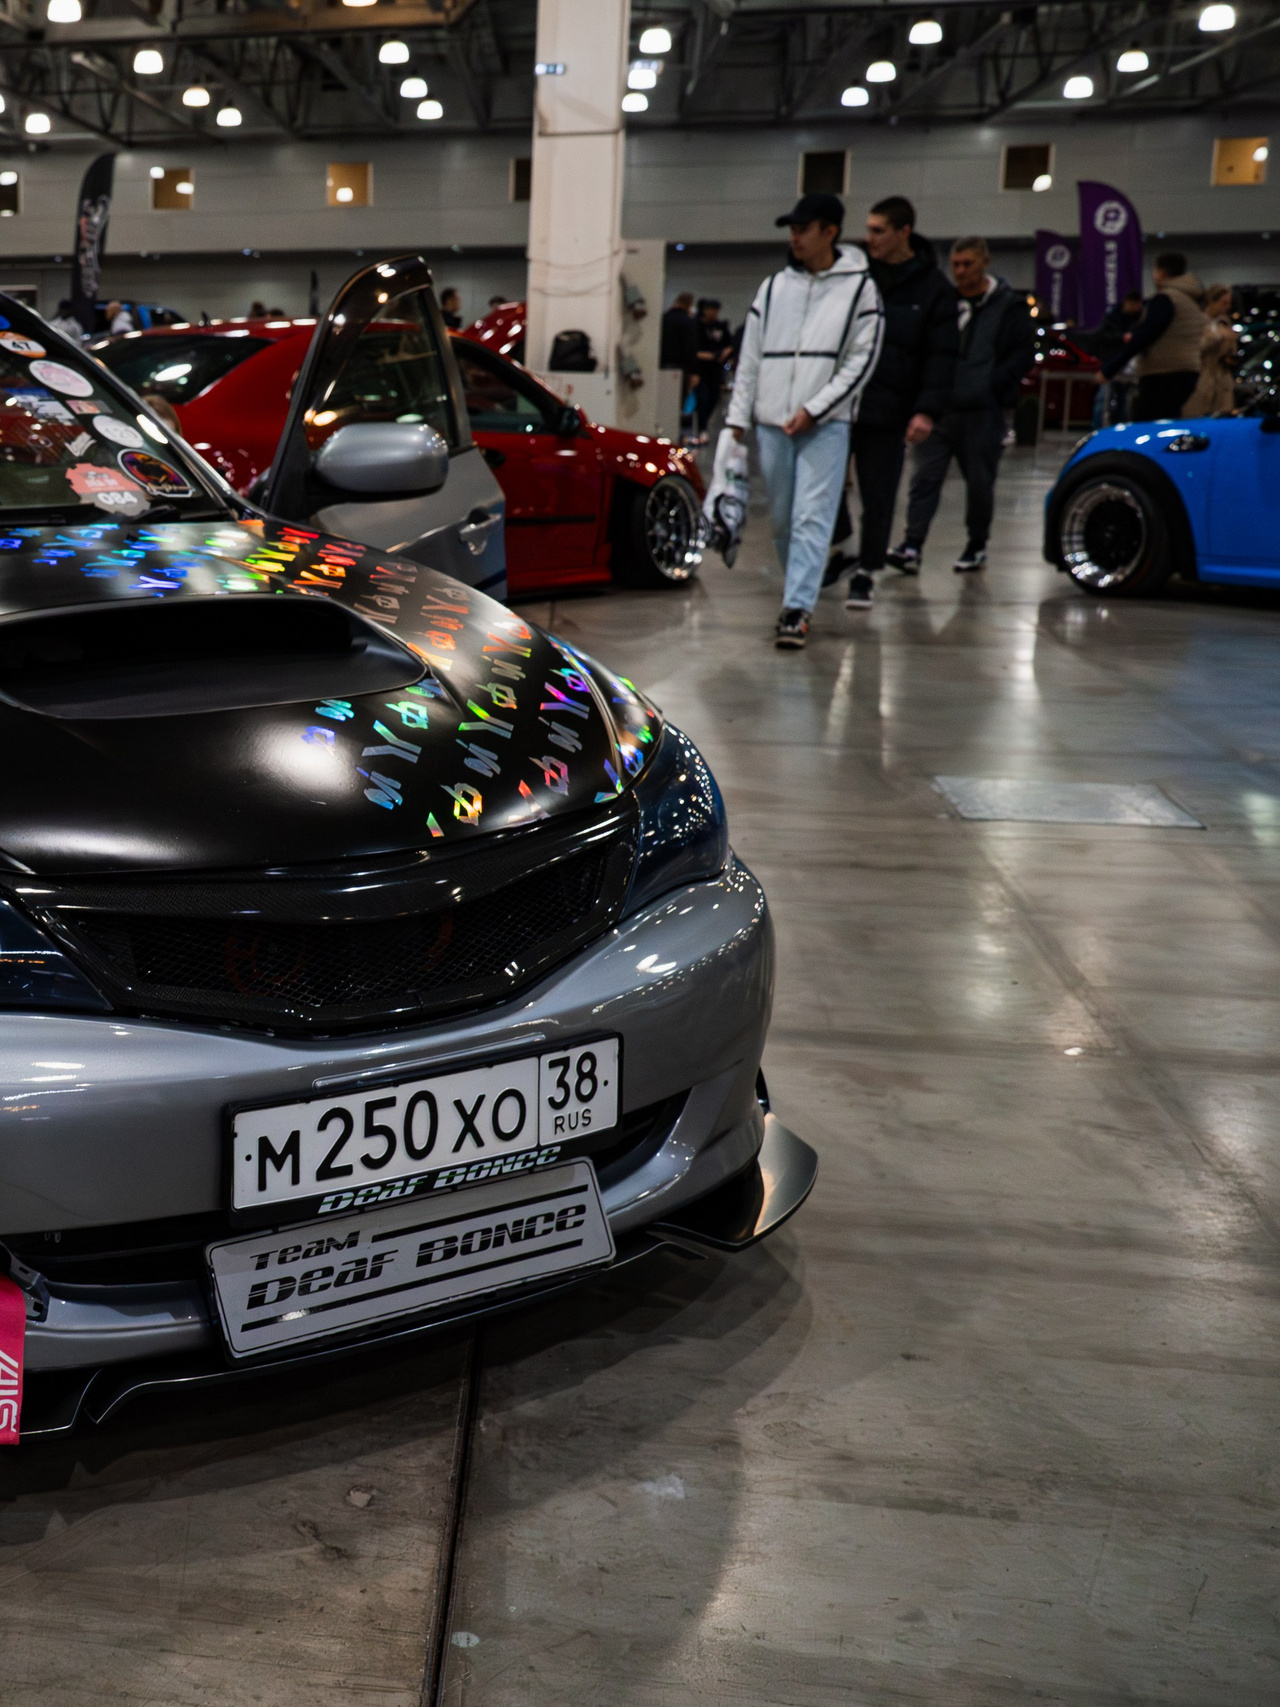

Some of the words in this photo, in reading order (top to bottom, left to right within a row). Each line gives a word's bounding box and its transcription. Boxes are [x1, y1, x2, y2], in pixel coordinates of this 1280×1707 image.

[96, 490, 139, 506] 084
[257, 1087, 527, 1192] M250XO
[547, 1051, 598, 1111] 38
[554, 1108, 592, 1135] RUS
